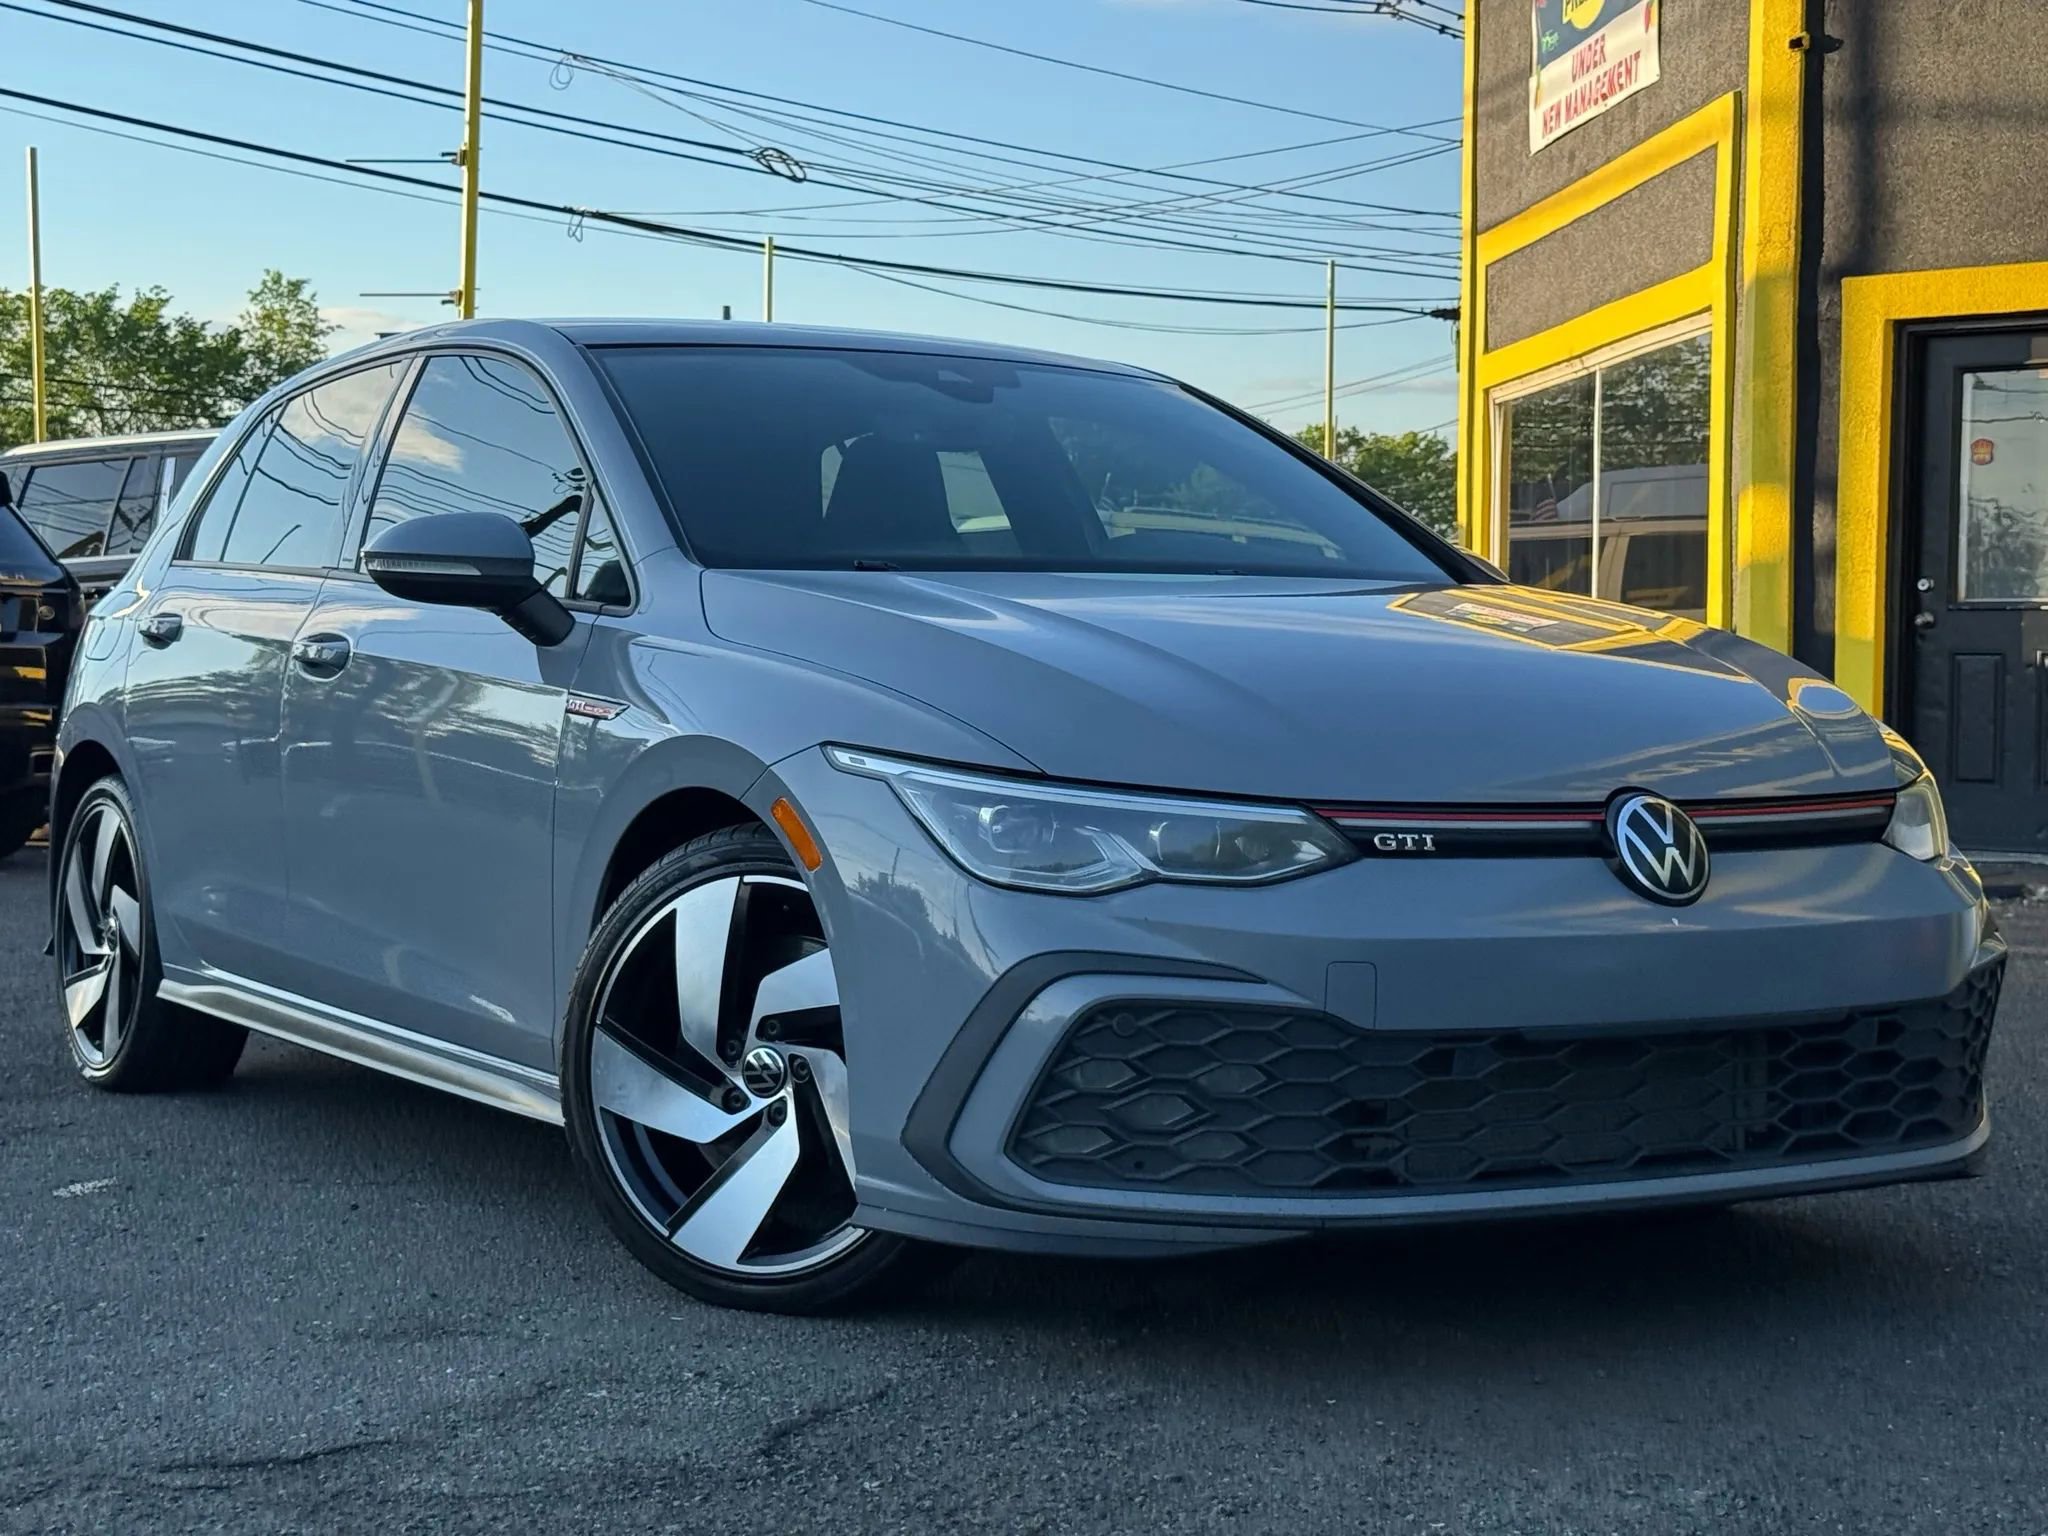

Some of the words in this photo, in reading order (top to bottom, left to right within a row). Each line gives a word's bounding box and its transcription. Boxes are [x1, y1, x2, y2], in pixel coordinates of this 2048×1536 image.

[1571, 33, 1606, 82] UNDER
[1542, 100, 1561, 137] NEW
[1565, 50, 1641, 123] MANAGEMENT
[1374, 833, 1436, 851] GTI
